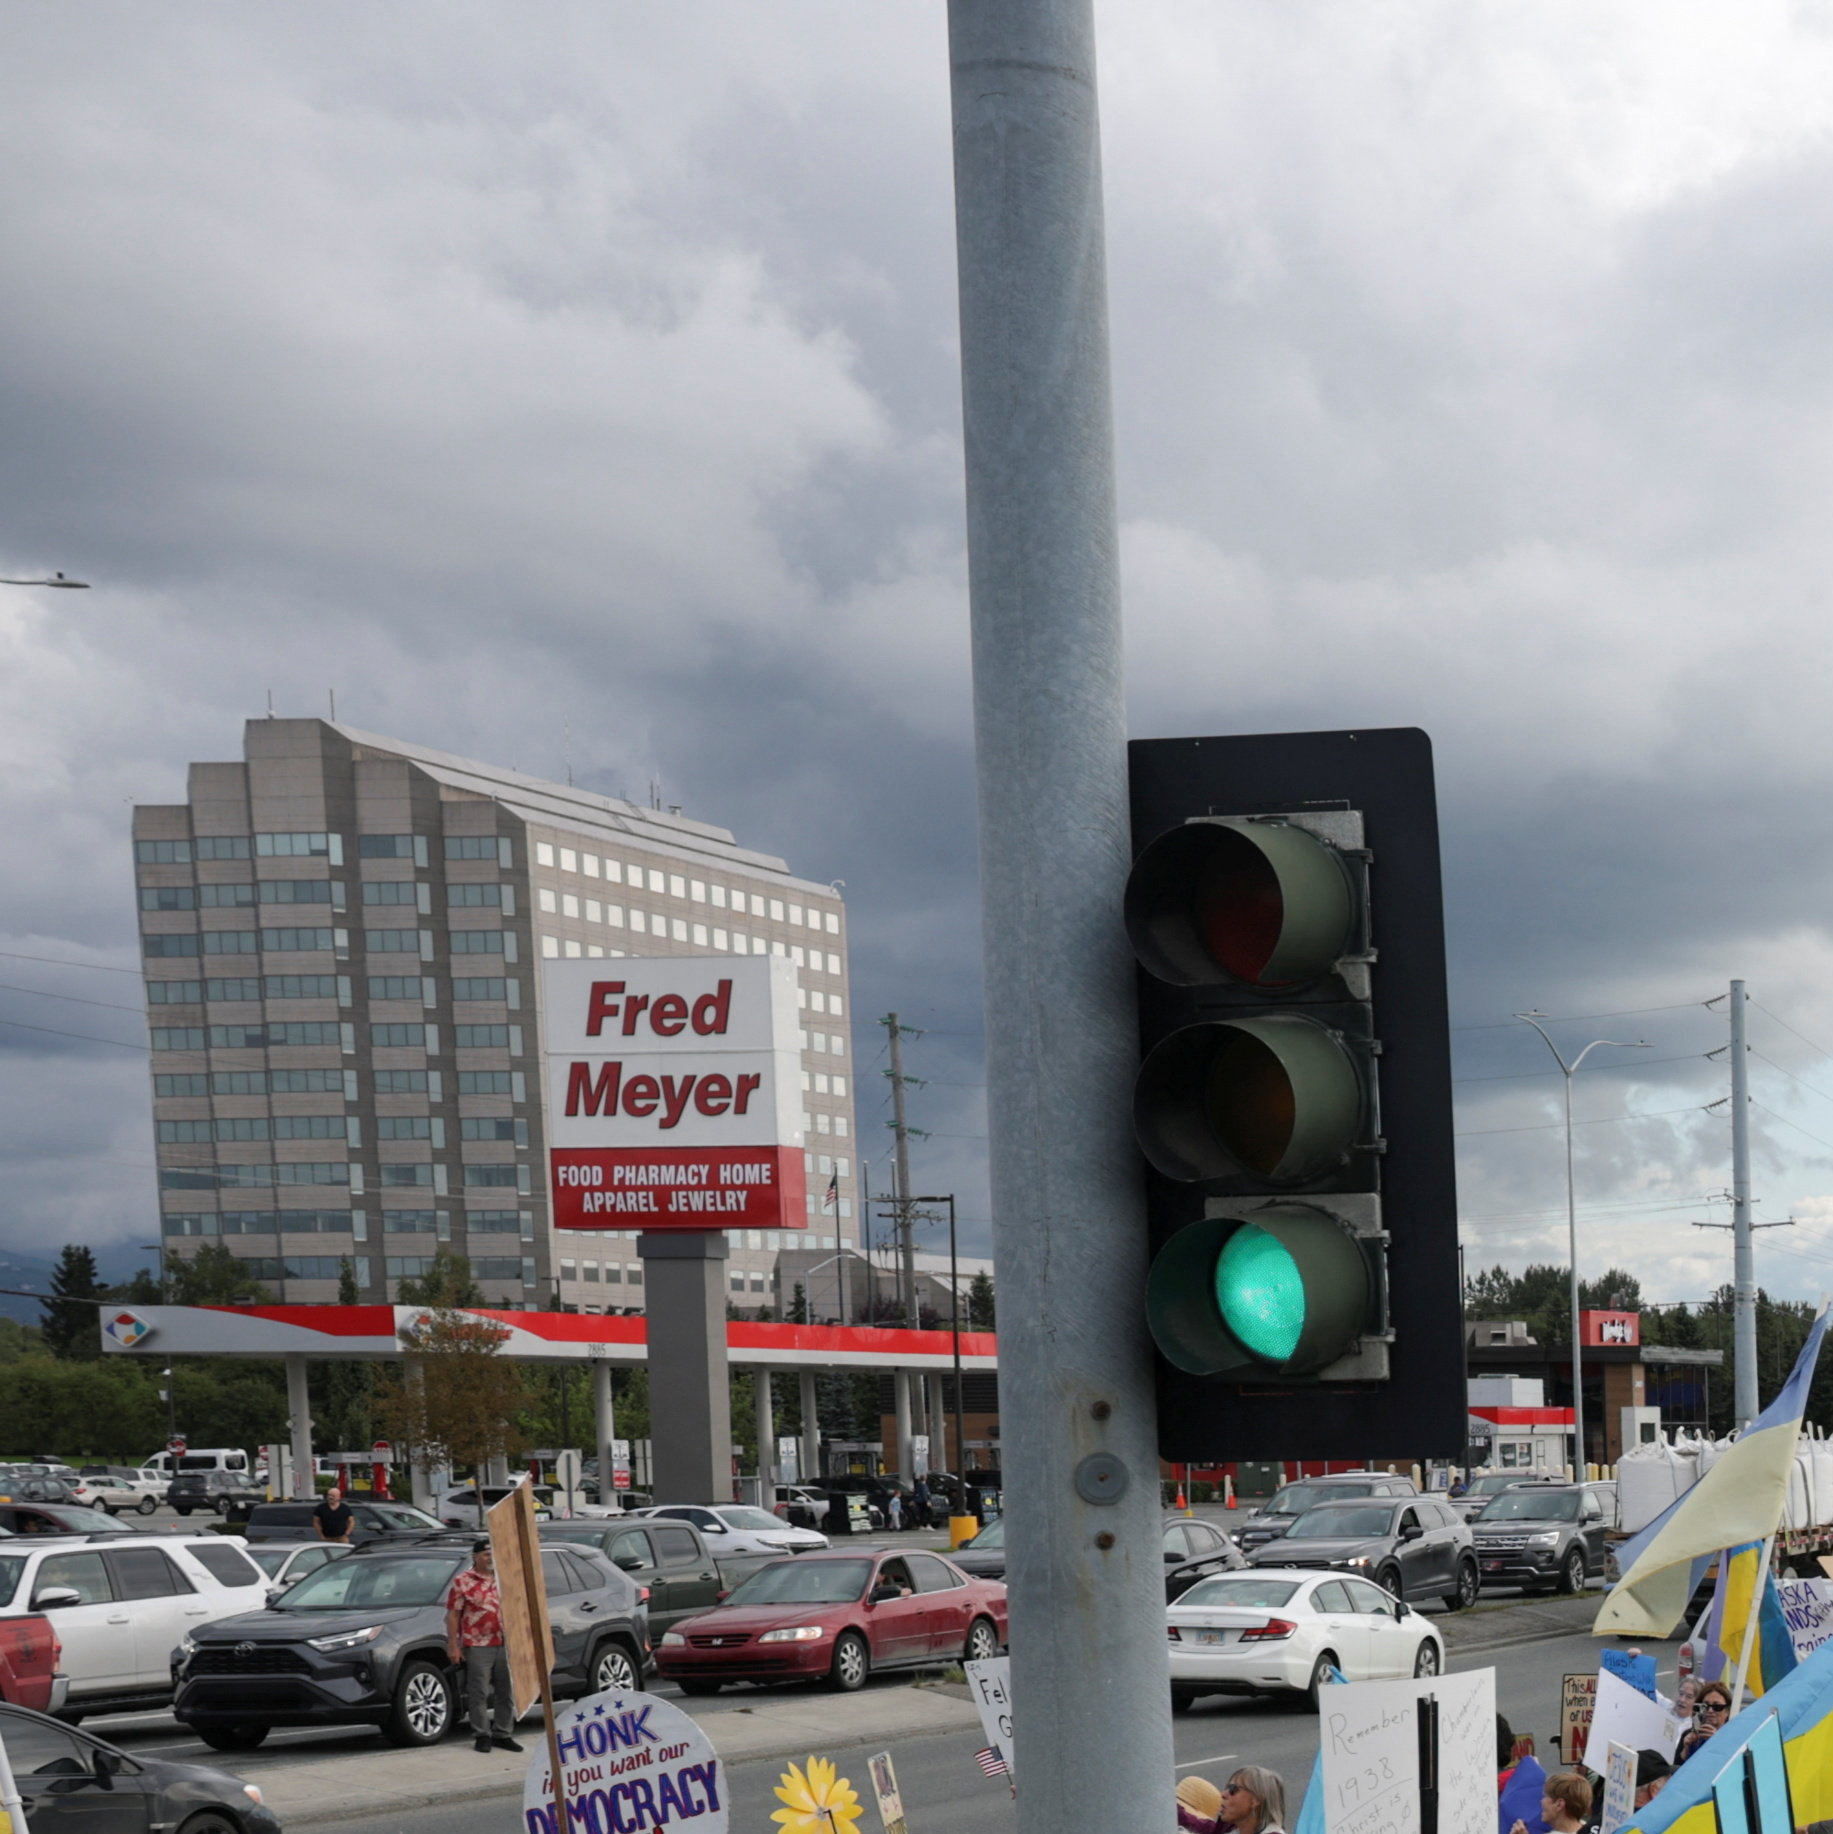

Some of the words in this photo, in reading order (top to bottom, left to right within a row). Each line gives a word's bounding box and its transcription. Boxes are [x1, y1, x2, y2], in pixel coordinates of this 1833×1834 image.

[586, 979, 733, 1036] Fred
[564, 1061, 761, 1130] Meyer
[558, 1165, 603, 1187] FOOD
[613, 1164, 710, 1186] PHARMACY
[719, 1163, 771, 1185] HOME
[583, 1191, 659, 1214] APPAREL
[668, 1190, 748, 1212] JEWELRY
[1564, 1678, 1586, 1693] This
[1565, 1696, 1588, 1708] when
[556, 1705, 662, 1767] HONK
[1328, 1709, 1411, 1755] Remember
[1570, 1711, 1580, 1722] of
[567, 1764, 604, 1797] you
[610, 1746, 654, 1776] want
[659, 1742, 690, 1763] our
[1338, 1757, 1395, 1809] 1938
